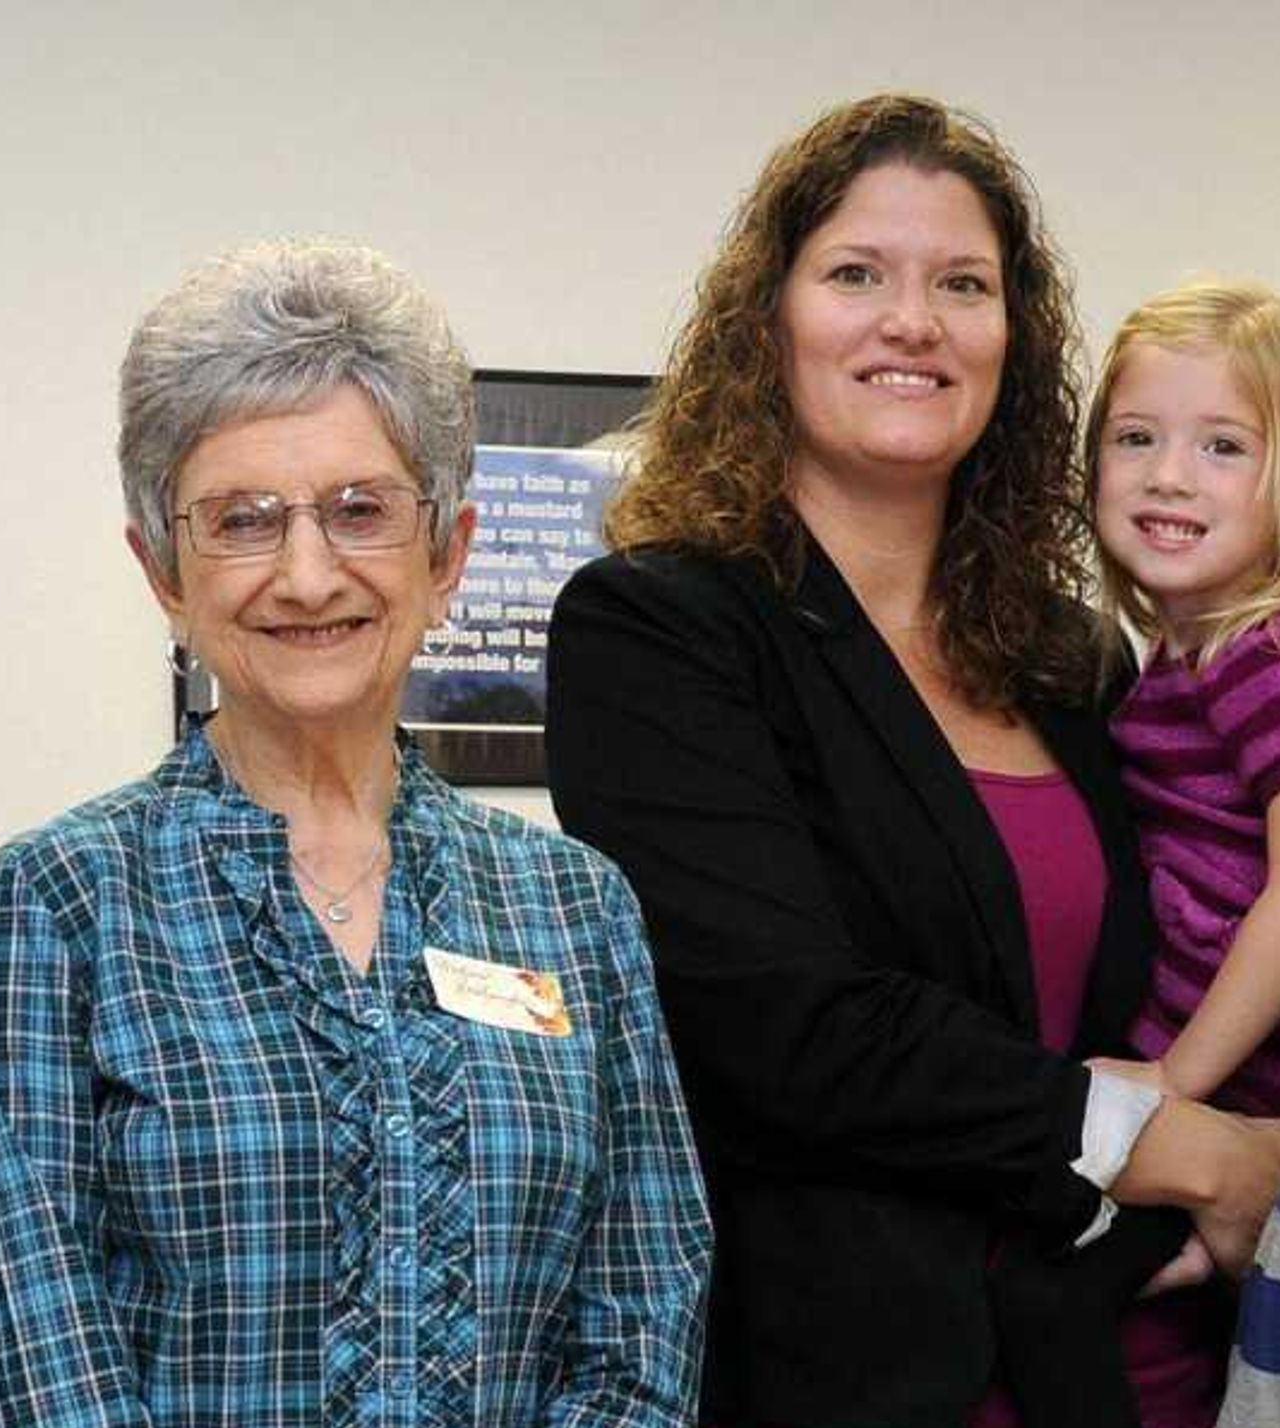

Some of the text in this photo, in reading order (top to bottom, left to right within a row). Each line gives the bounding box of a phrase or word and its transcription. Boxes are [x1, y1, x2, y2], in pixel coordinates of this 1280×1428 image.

[523, 473, 565, 492] faith
[568, 479, 591, 493] as
[507, 502, 584, 519] mustard
[473, 528, 497, 542] ou
[500, 528, 534, 543] can
[537, 529, 568, 549] say
[486, 629, 522, 647] will
[513, 653, 542, 673] for
